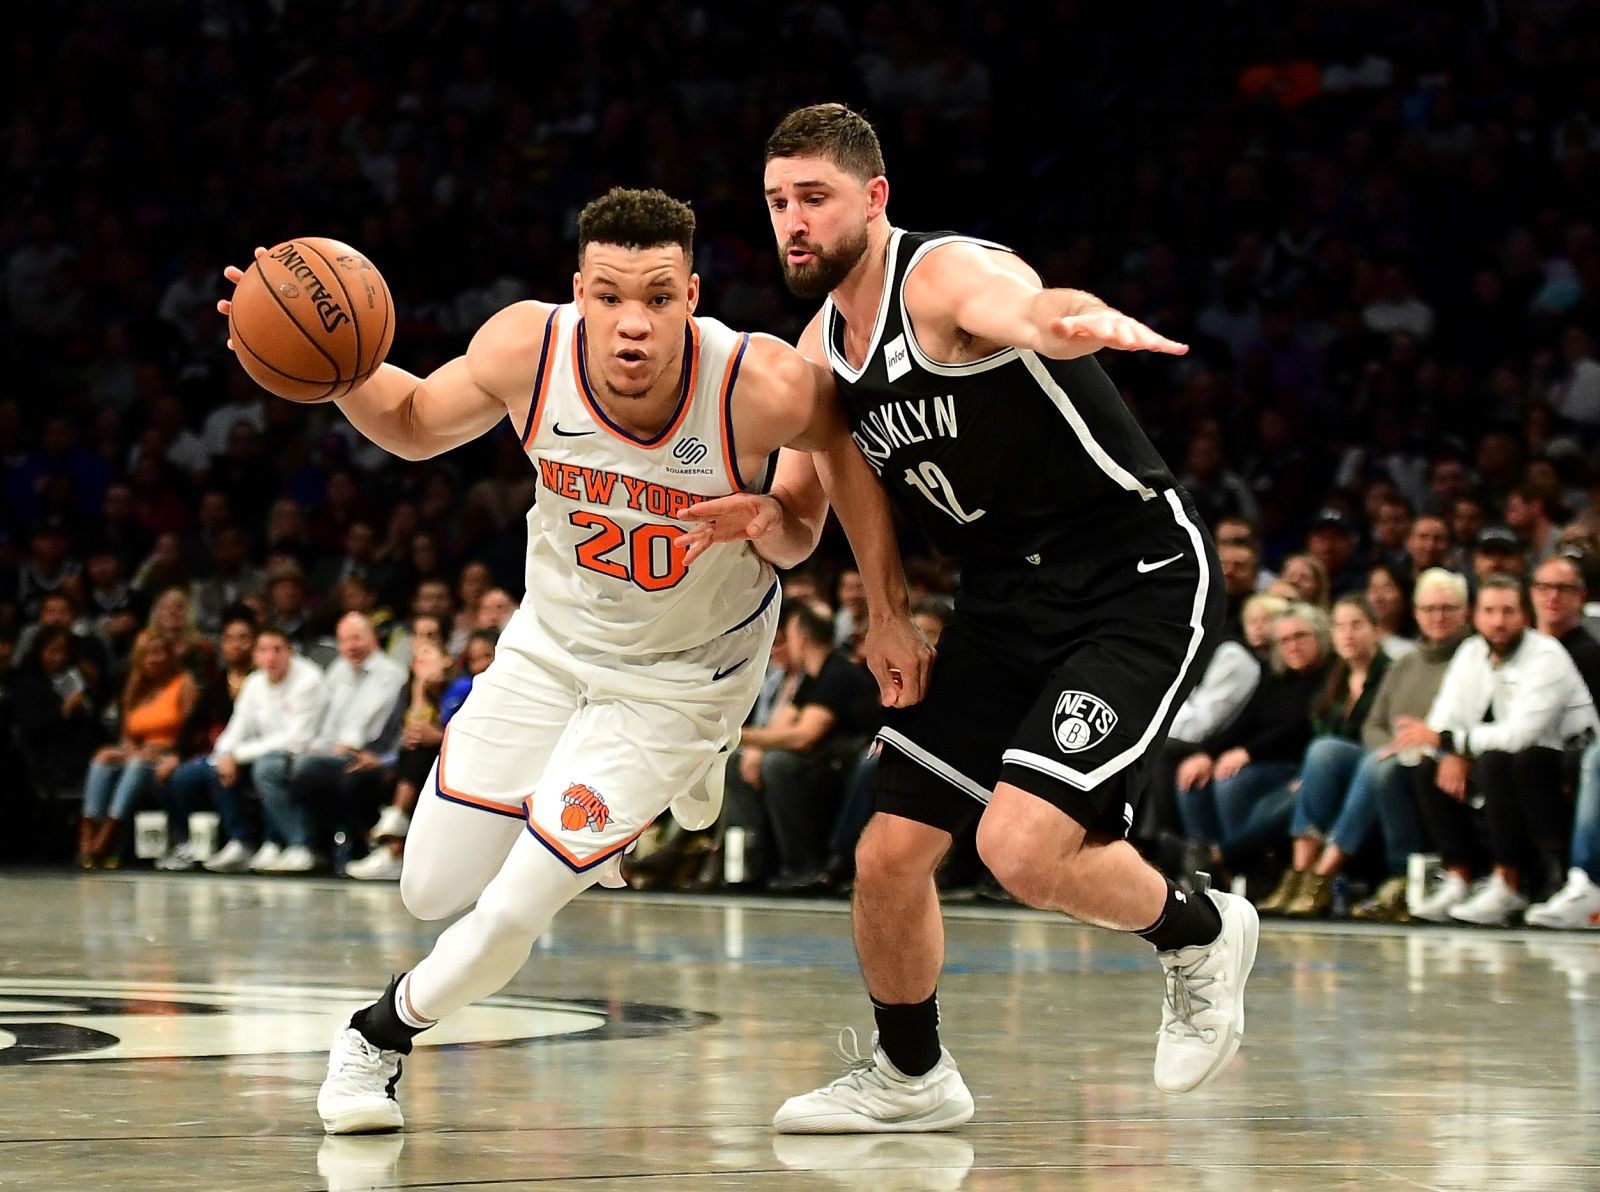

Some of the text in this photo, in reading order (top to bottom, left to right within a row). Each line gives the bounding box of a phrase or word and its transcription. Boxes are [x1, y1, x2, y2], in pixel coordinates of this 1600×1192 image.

[270, 244, 350, 333] SPALDING
[888, 349, 905, 368] infor
[538, 458, 720, 520] NEW YOR
[665, 467, 714, 475] SQUARESPACE
[904, 461, 986, 525] 12
[568, 510, 689, 592] 20
[1057, 693, 1114, 735] NETS
[1066, 723, 1082, 744] B
